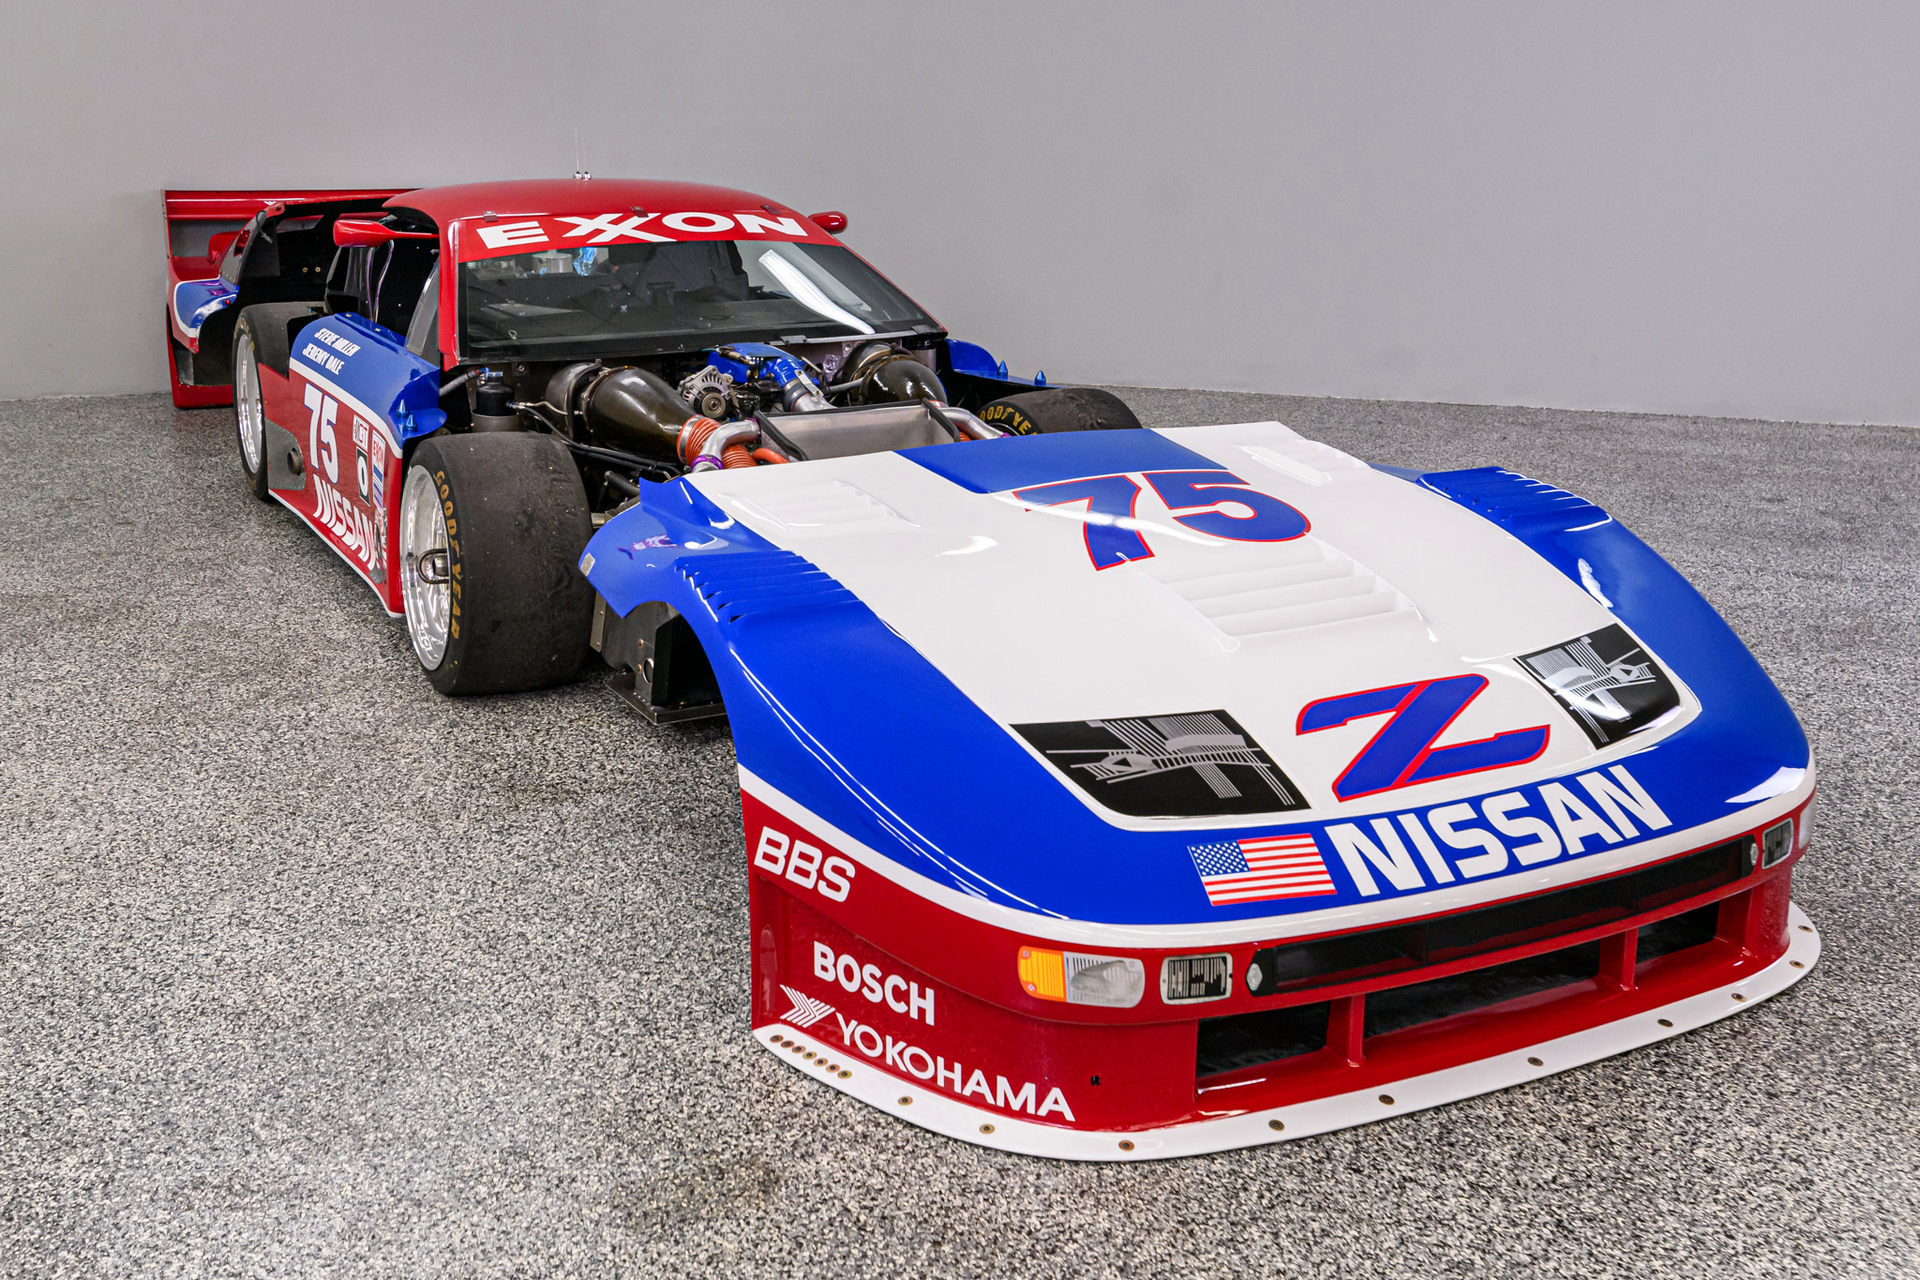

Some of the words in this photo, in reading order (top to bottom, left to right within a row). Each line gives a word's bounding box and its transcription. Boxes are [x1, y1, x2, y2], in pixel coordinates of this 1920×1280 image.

[476, 212, 809, 249] EXXON
[302, 342, 331, 366] JEREMY
[325, 355, 345, 375] DALE
[314, 327, 341, 346] STEVE
[304, 382, 339, 485] 75
[313, 474, 380, 571] NISSAN
[435, 470, 462, 639] GOODYEAR
[1011, 471, 1312, 572] 75
[1296, 673, 1551, 802] Z
[754, 826, 855, 903] BBS
[1324, 764, 1673, 897] NISSAN
[813, 941, 935, 1026] BOSCH
[836, 1011, 1076, 1122] YOKOHAMA
